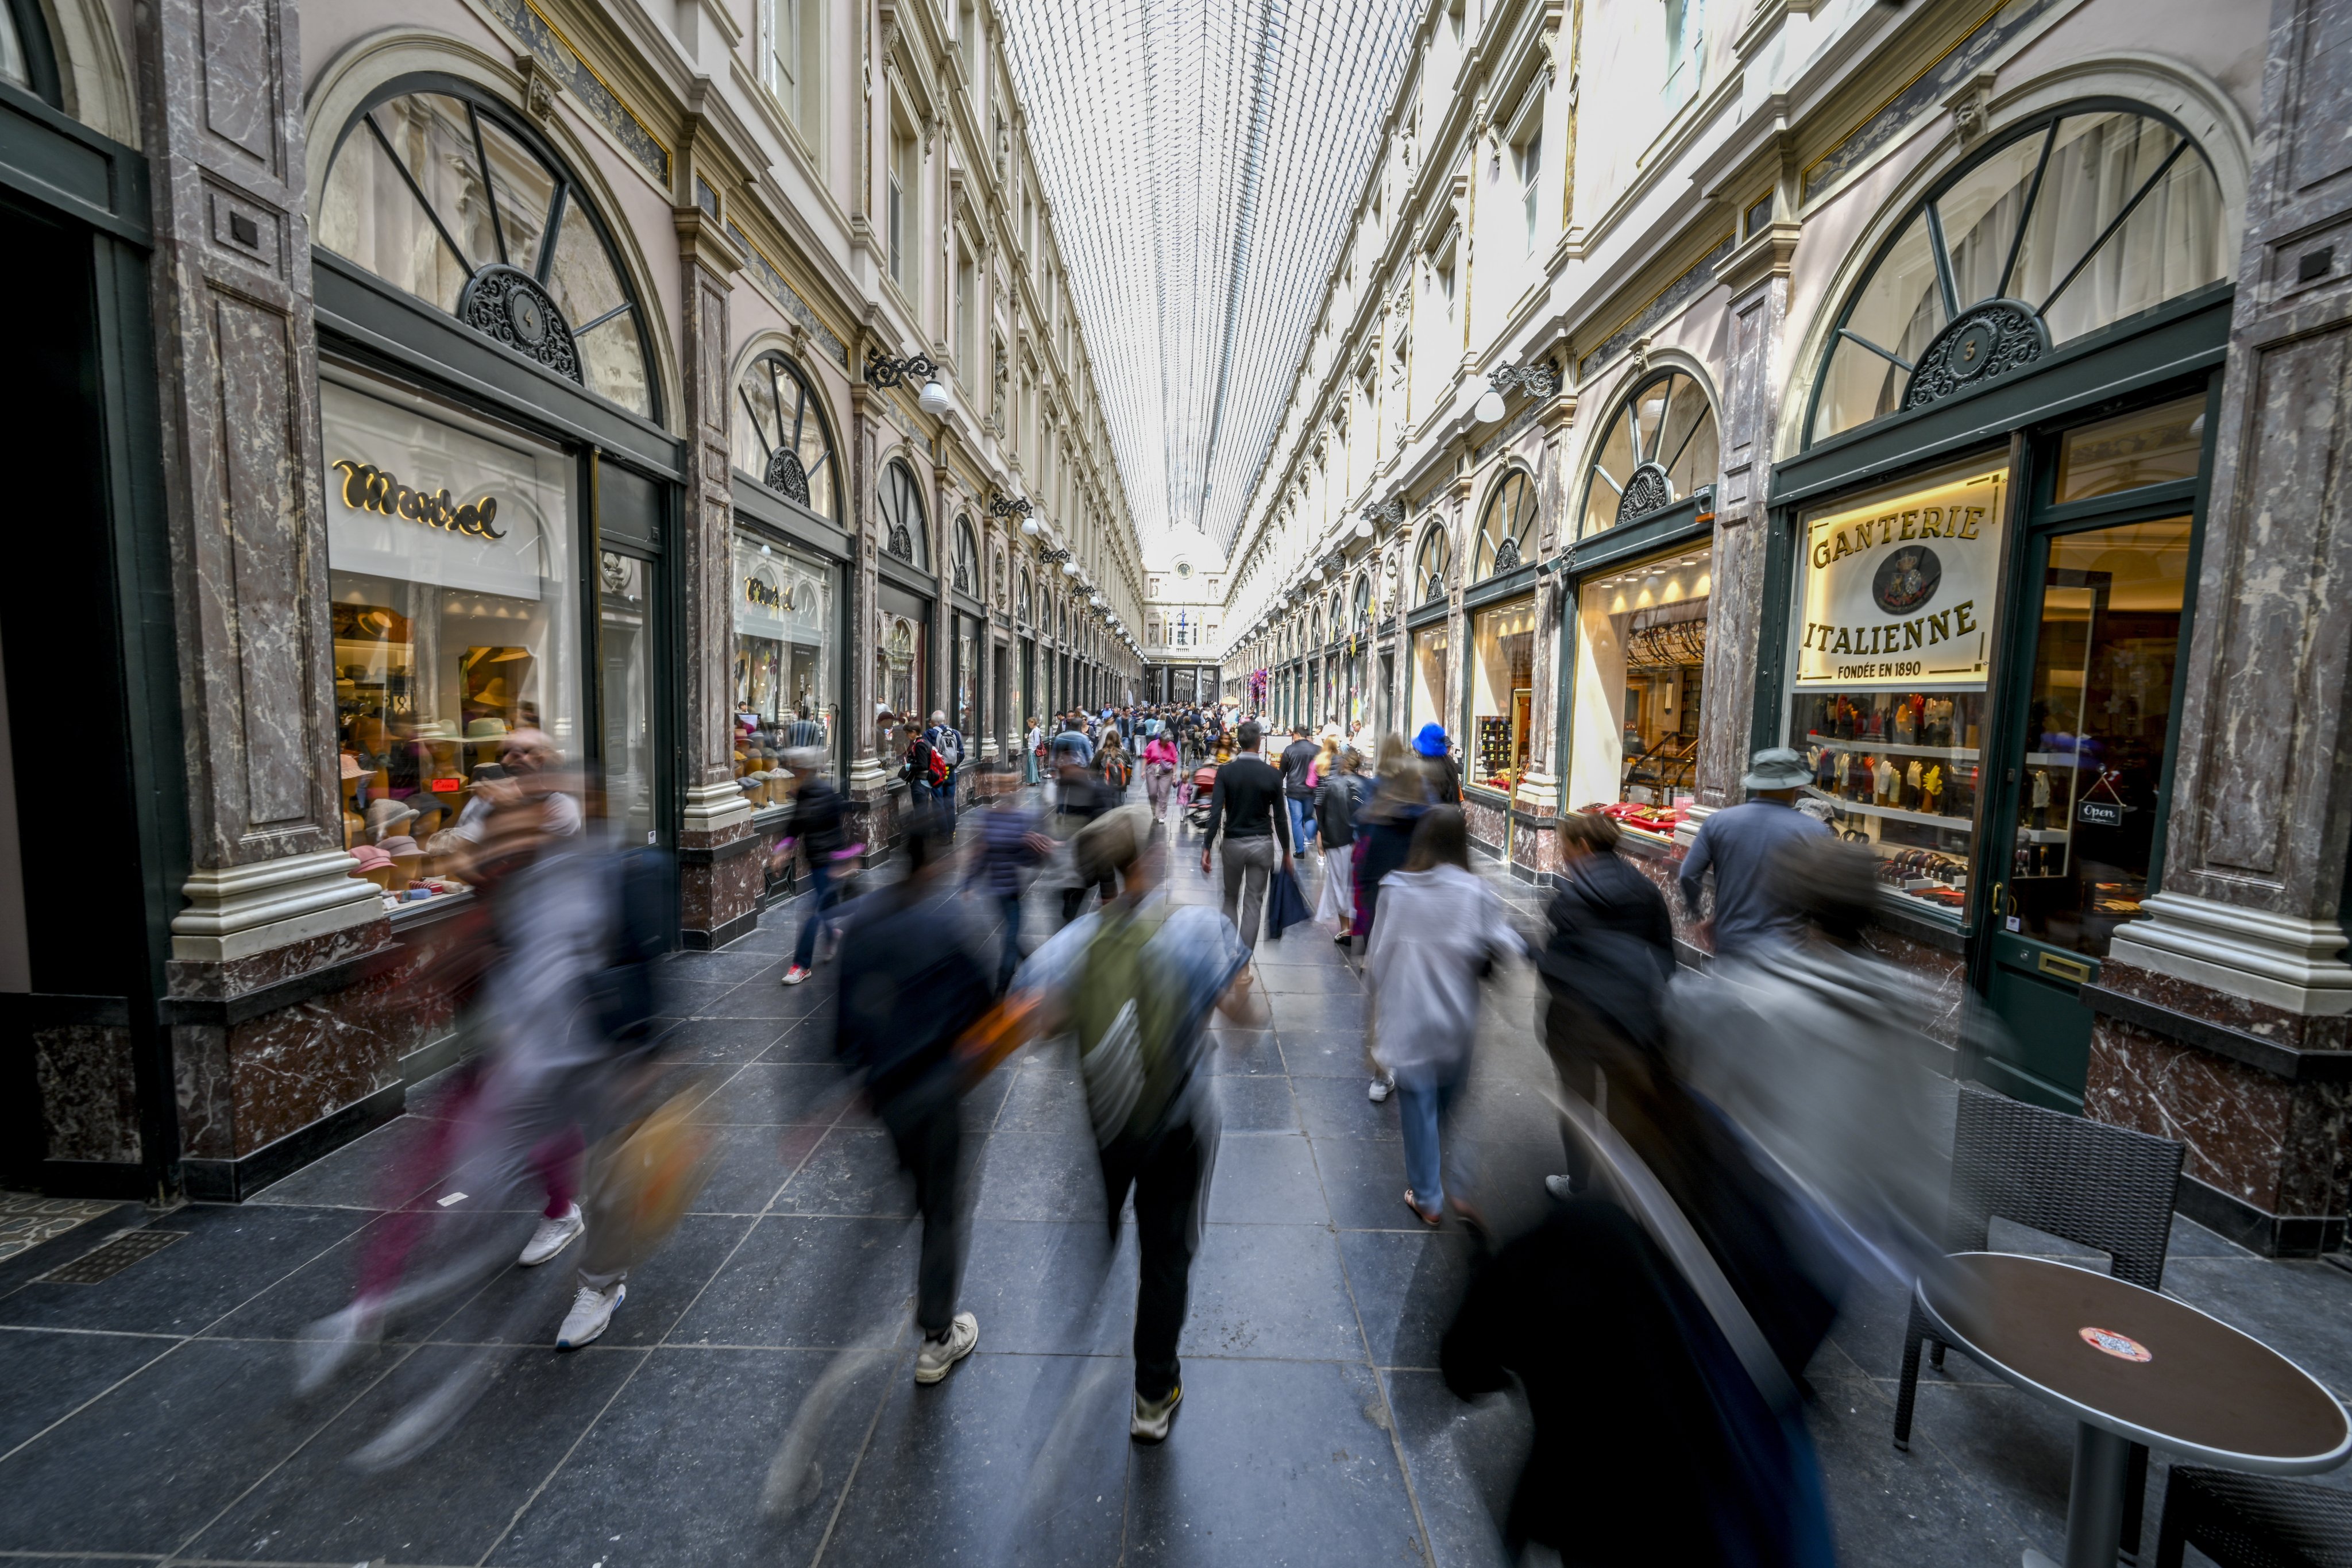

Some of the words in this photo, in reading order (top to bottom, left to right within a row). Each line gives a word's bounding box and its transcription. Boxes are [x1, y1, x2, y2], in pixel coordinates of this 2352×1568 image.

[523, 308, 534, 327] 4
[1963, 339, 1976, 361] 3
[332, 460, 507, 539] Monsel
[1813, 506, 1986, 569] GANTERIE
[1803, 600, 1977, 654] ITALIENNE
[1838, 662, 1875, 679] FONDÉE
[1879, 663, 1893, 677] EN
[1895, 661, 1921, 676] 1890
[2084, 805, 2116, 819] Open
